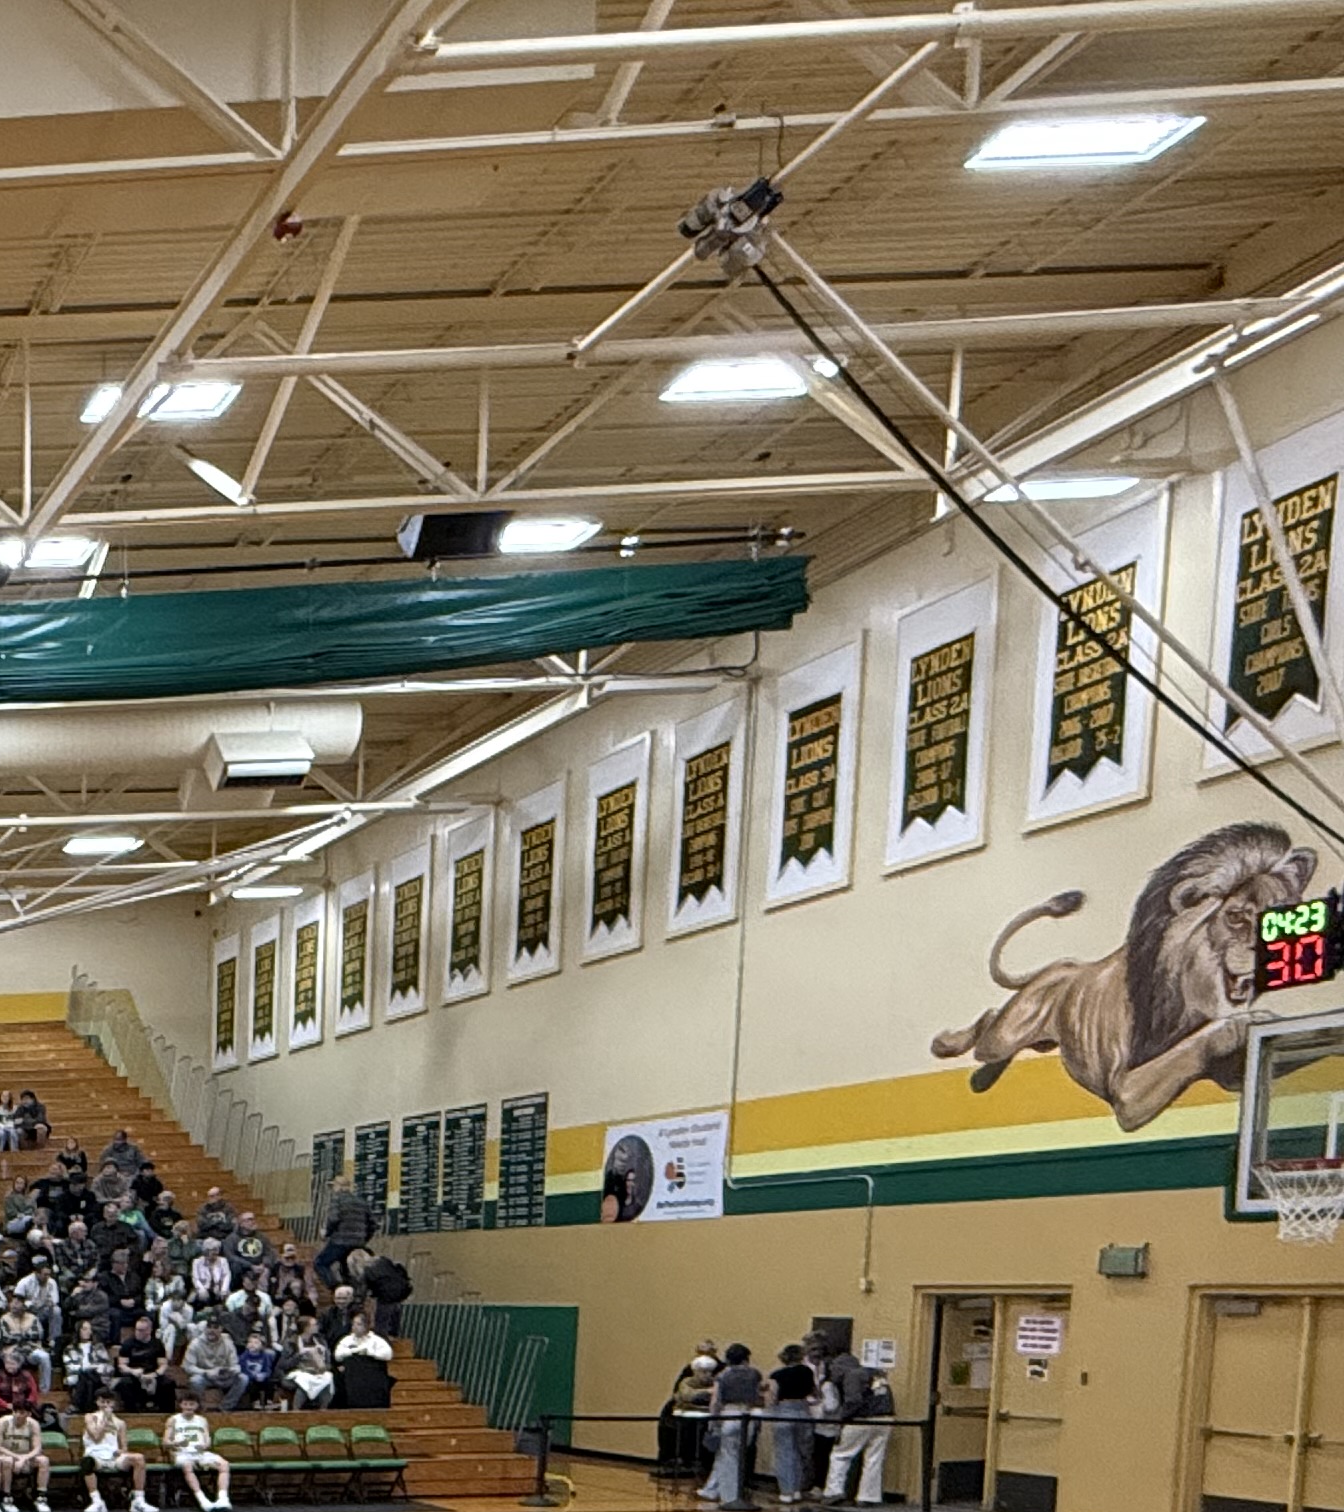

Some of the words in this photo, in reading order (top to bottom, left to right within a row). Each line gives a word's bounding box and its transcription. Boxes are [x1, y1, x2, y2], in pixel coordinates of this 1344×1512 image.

[1248, 520, 1320, 574] LINS
[1236, 566, 1286, 604] CLAS
[1266, 934, 1323, 987] 30
